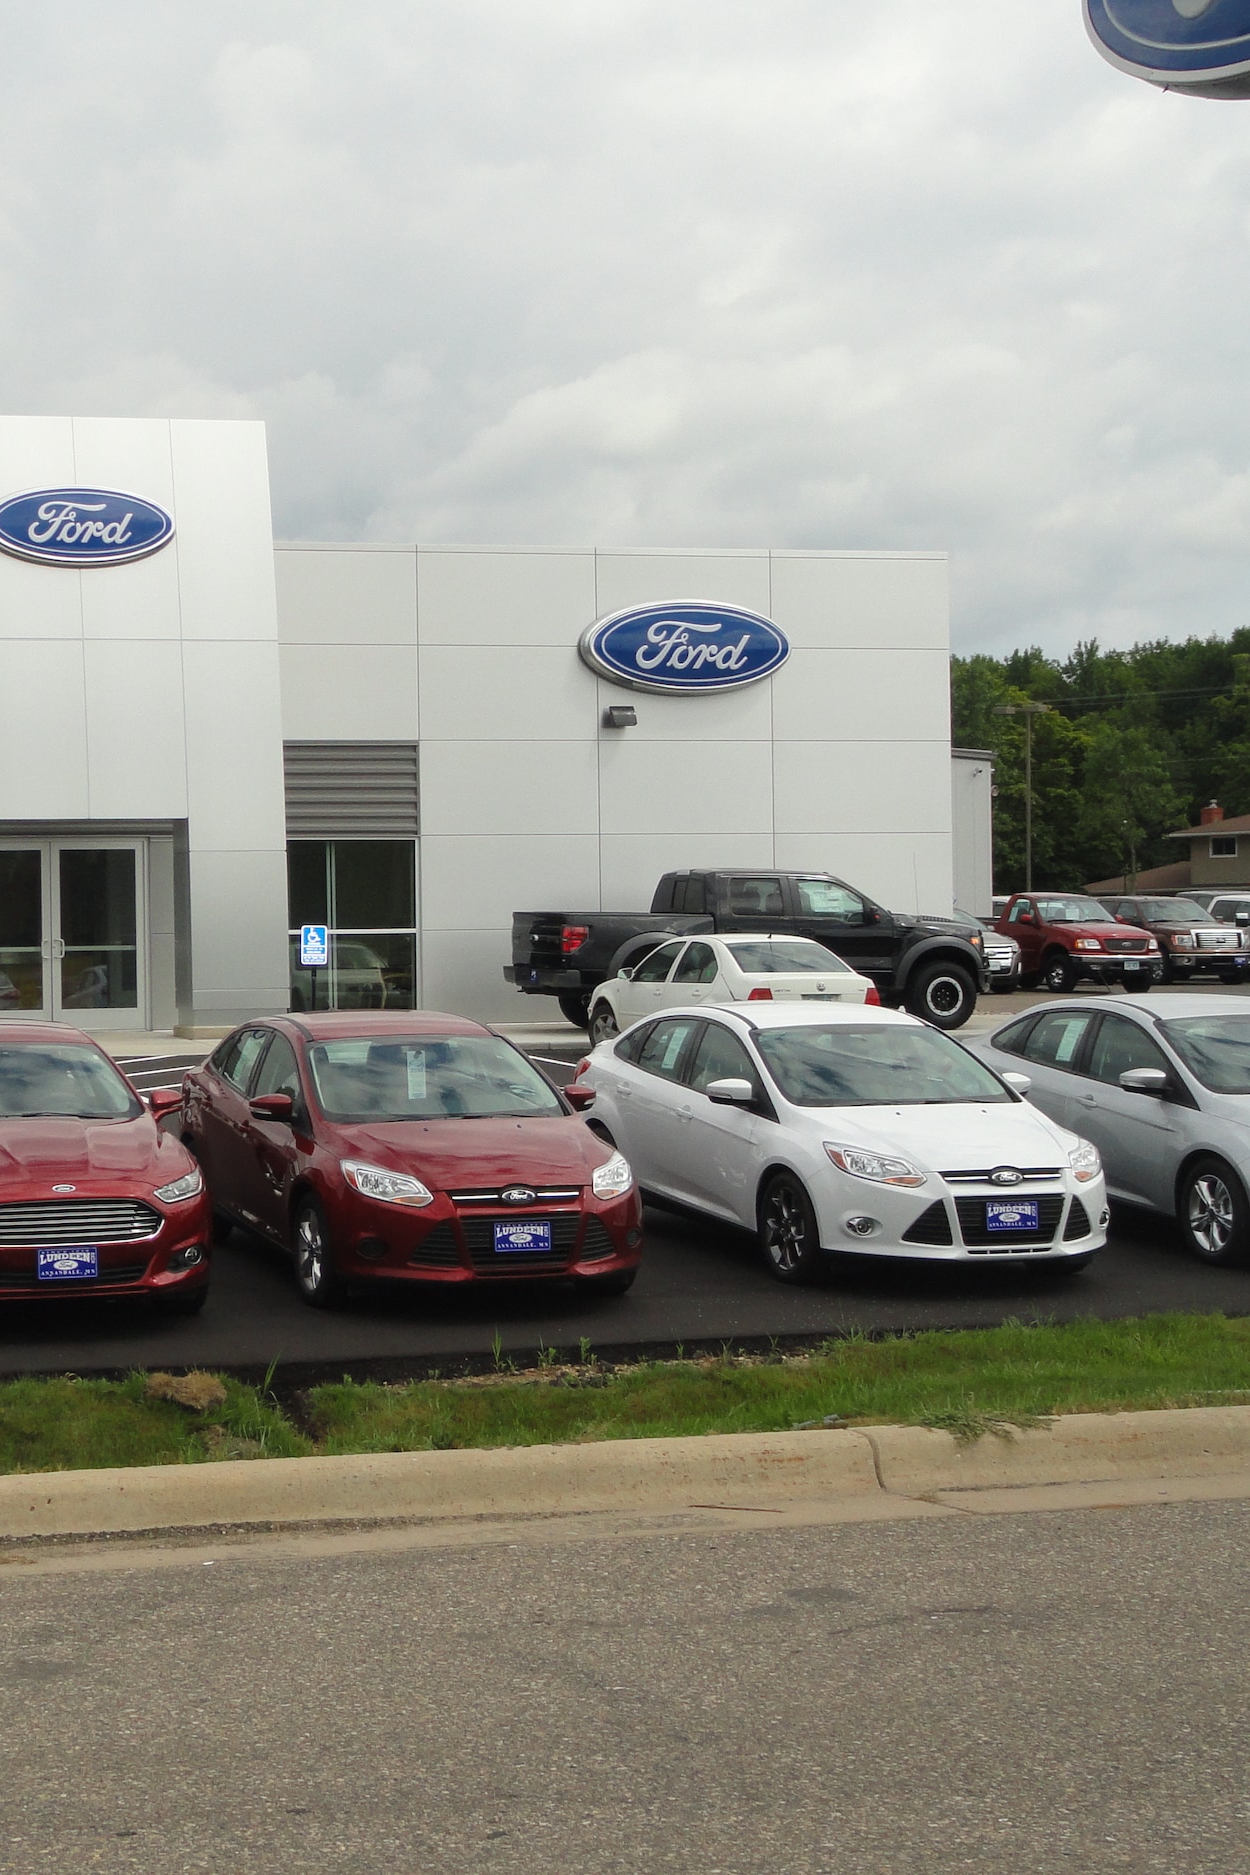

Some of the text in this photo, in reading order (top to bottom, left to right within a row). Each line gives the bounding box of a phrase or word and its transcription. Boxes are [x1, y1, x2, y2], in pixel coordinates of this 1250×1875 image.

[28, 501, 133, 544] Ford
[635, 620, 750, 670] Ford
[987, 1205, 1031, 1217] LUNDEEN
[496, 1225, 544, 1238] LUNDEEN
[40, 1252, 91, 1265] LUNDEEN
